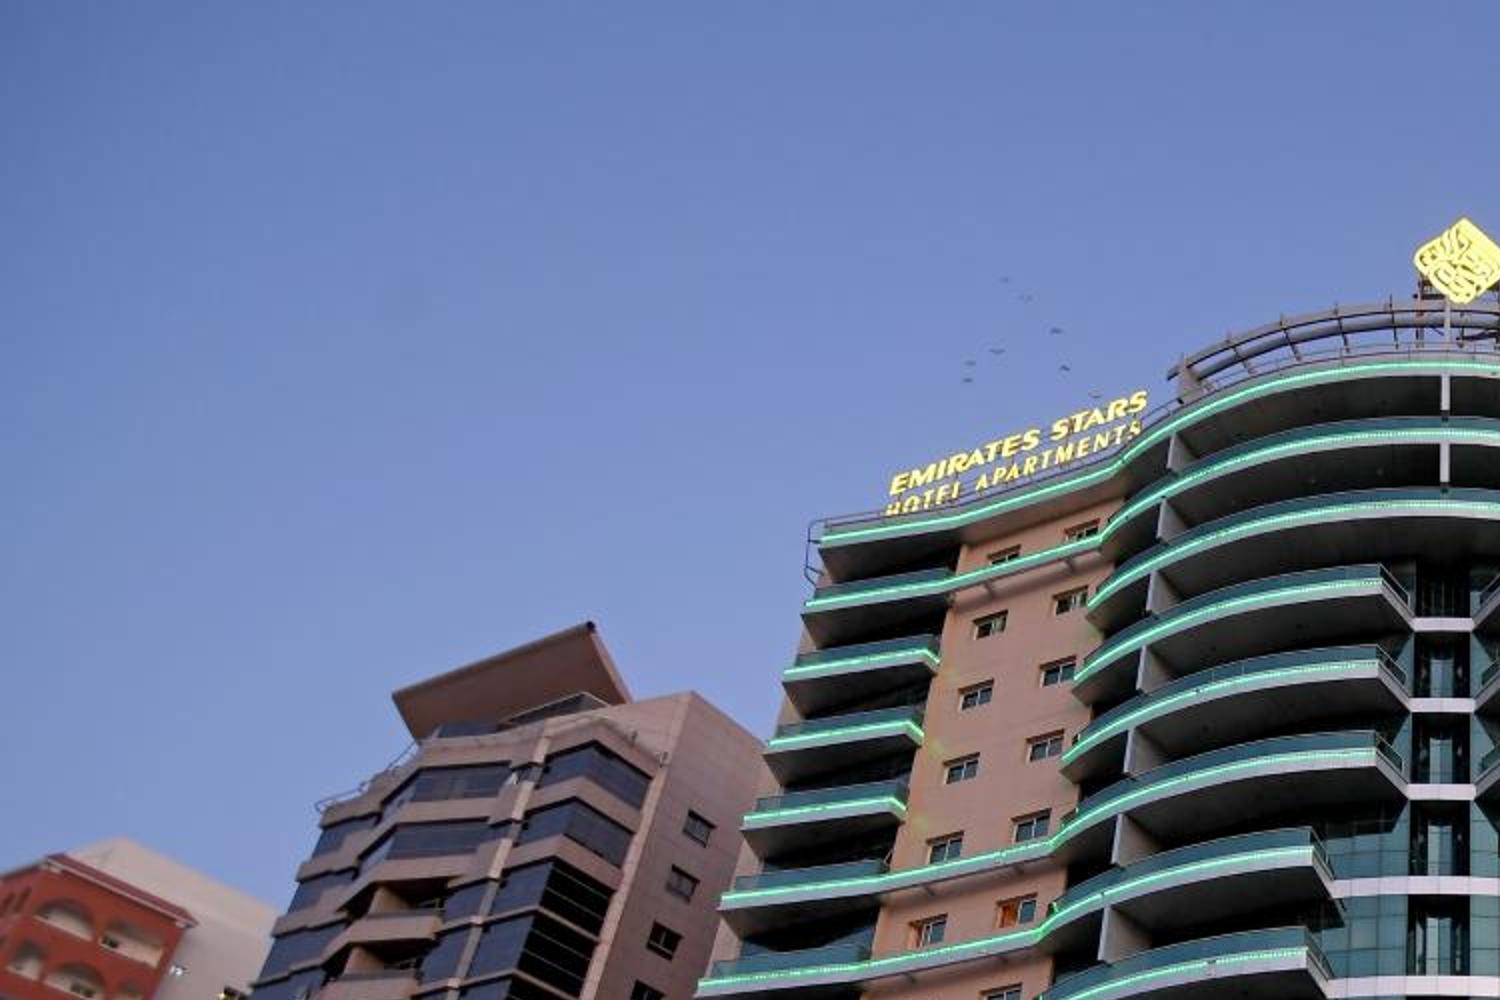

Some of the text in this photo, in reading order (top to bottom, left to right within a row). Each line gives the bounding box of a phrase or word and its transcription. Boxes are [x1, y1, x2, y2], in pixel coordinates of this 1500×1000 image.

[889, 391, 1148, 495] EMIRATES STARS
[975, 420, 1142, 491] APARTMENTS
